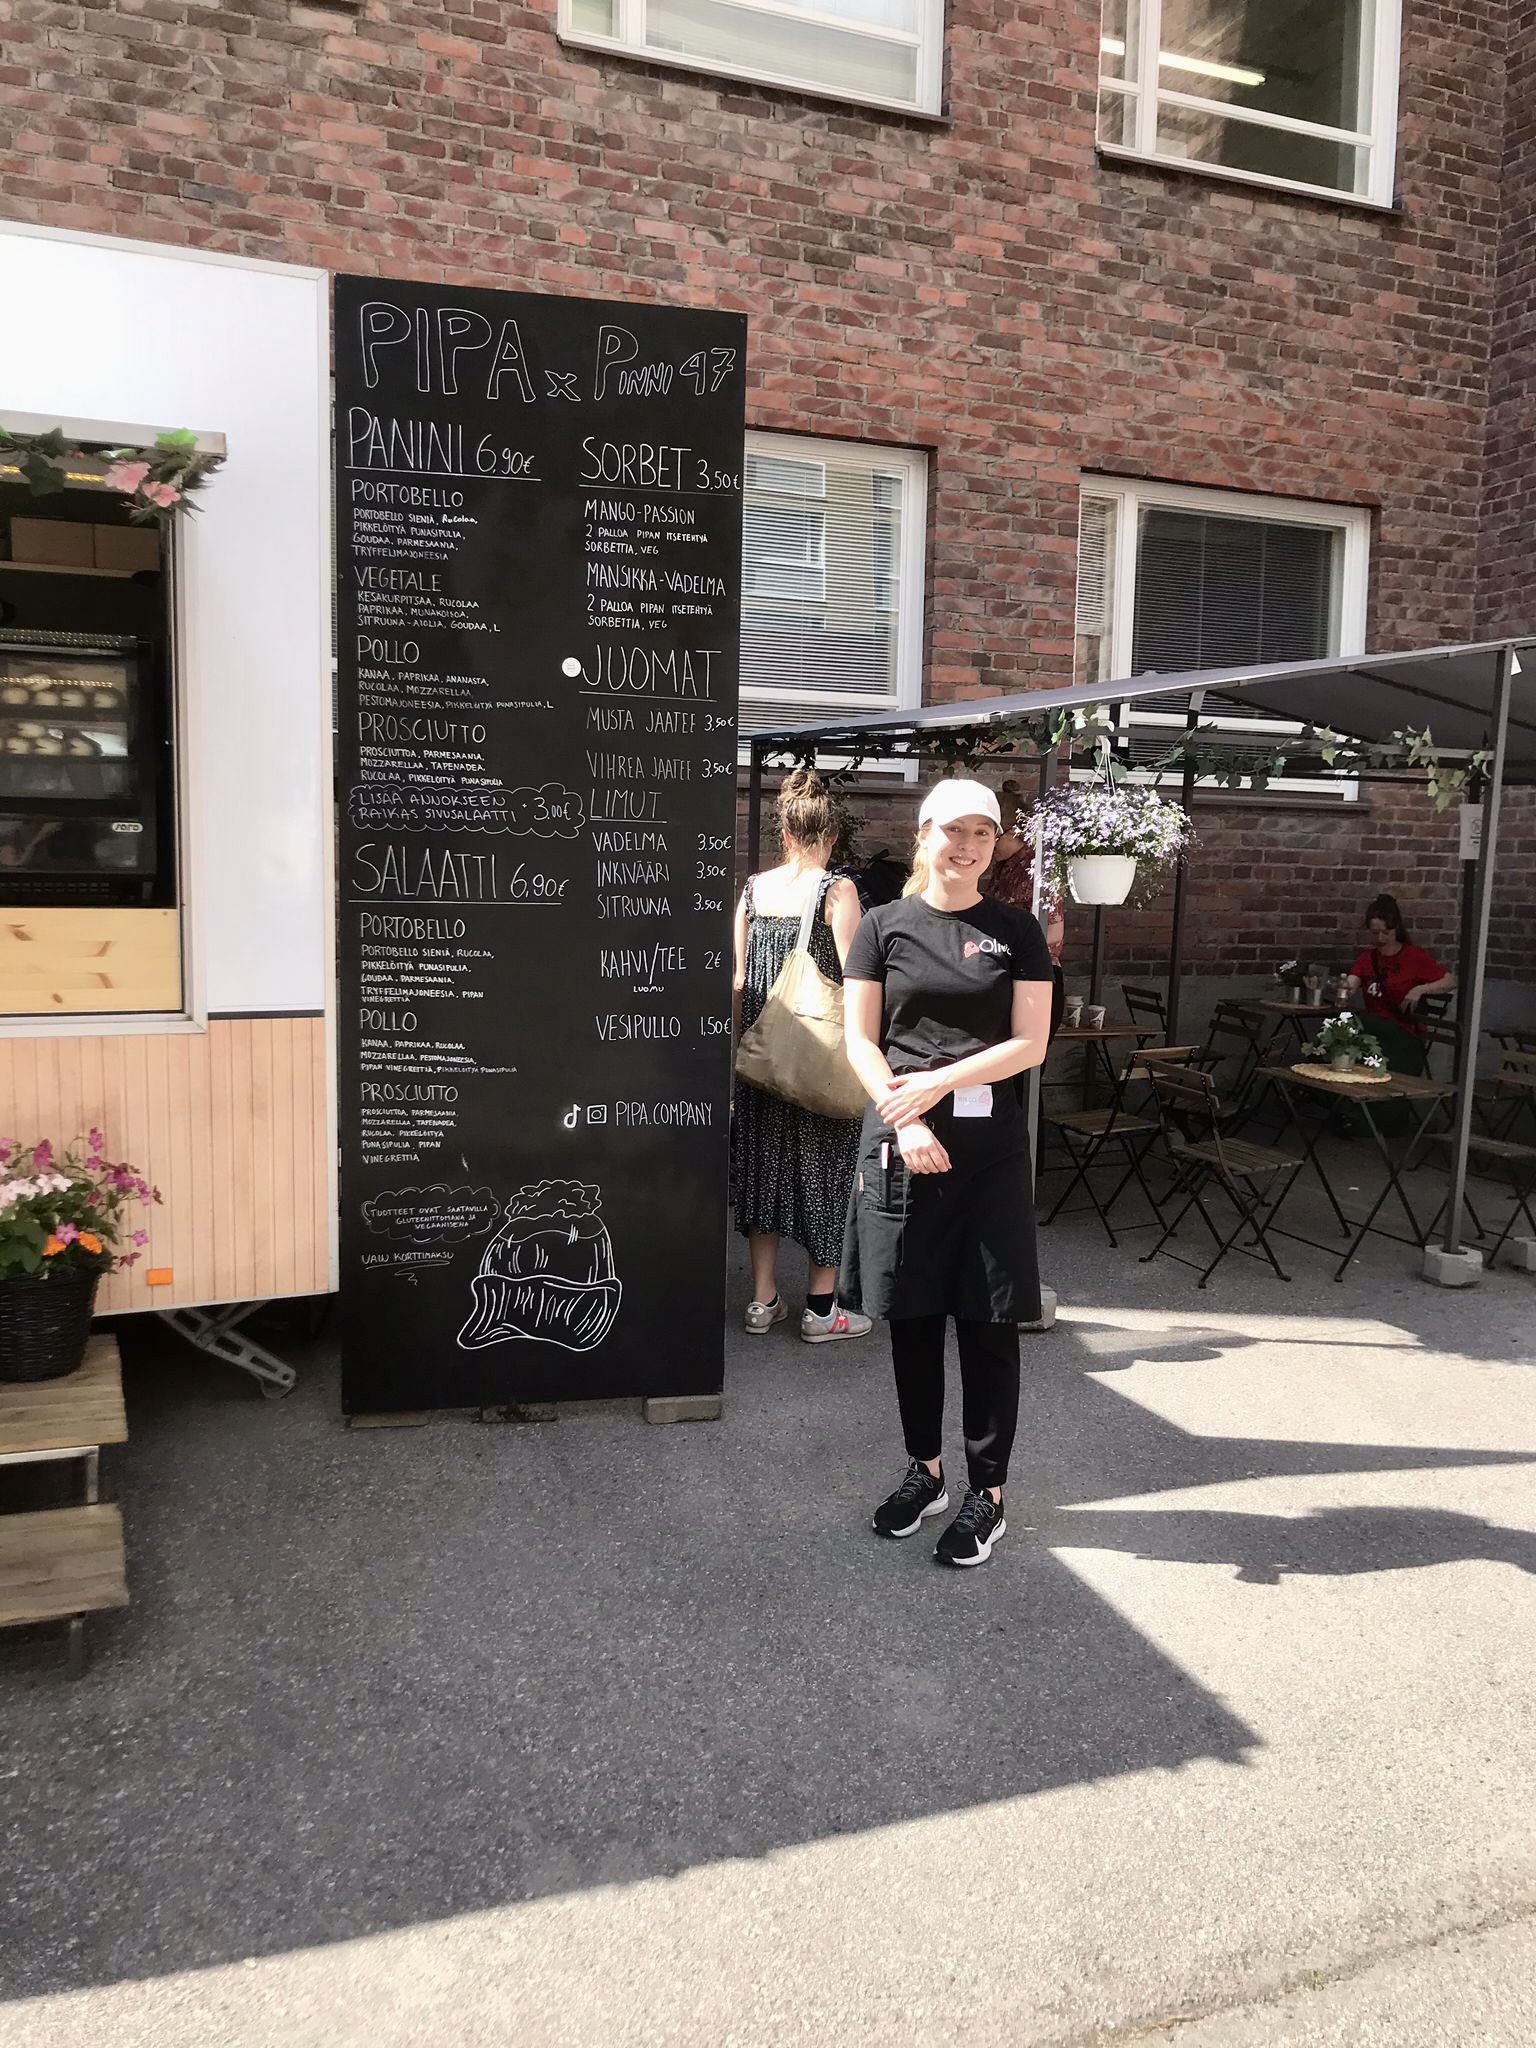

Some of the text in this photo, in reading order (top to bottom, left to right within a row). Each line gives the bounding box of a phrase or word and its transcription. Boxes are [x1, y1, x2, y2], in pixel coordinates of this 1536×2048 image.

[361, 302, 536, 402] PIPA
[679, 347, 736, 396] 47
[349, 407, 463, 474] PANINI
[581, 437, 692, 491] SORBET
[352, 479, 464, 508] PORTOBELLO
[353, 507, 405, 522] PORTOBELLO
[584, 498, 696, 525] MANGO-PASSION
[585, 523, 593, 538] 2
[598, 527, 629, 538] PALLOA
[636, 530, 661, 541] PIPAN
[640, 545, 659, 555] VEG
[353, 565, 443, 592] VEGETALE
[586, 561, 727, 597] MANSIKKA-VADELMA
[587, 593, 595, 612] 2
[600, 598, 634, 613] PALLOA
[640, 602, 665, 614] PIPAN
[648, 619, 668, 630] VEG
[357, 634, 420, 664] POLLO
[582, 644, 722, 698] JUOMAT
[358, 711, 487, 744] PROSCIUTTO
[586, 706, 635, 732] MUSTA
[409, 794, 506, 807] ANNOKSEEN
[590, 788, 663, 819] LIMUT
[358, 807, 517, 823] RAIKAS SIVUSALAATTI
[592, 831, 668, 852] VADELMA
[352, 843, 497, 899] SALAATTI
[597, 893, 672, 919] SITRUUNA
[360, 911, 466, 940] PORTOBELLO
[361, 943, 419, 958] PORTOBELLO
[600, 942, 722, 985] KAHVI/TEE 2€
[462, 990, 484, 999] PIPAN
[633, 985, 665, 993] LUOMU
[360, 1008, 418, 1032] POLLO
[595, 1013, 681, 1041] VESIPULLO
[360, 1062, 383, 1071] PIPAN
[361, 1081, 459, 1102] PROSCIUTTO
[615, 1100, 713, 1127] PIPA.COMPANY
[418, 1141, 441, 1149] PIPAN
[370, 1204, 489, 1217] TUOTTEET OVAT SAATAVILLA
[394, 1251, 455, 1262] KORTTIMAKSU
